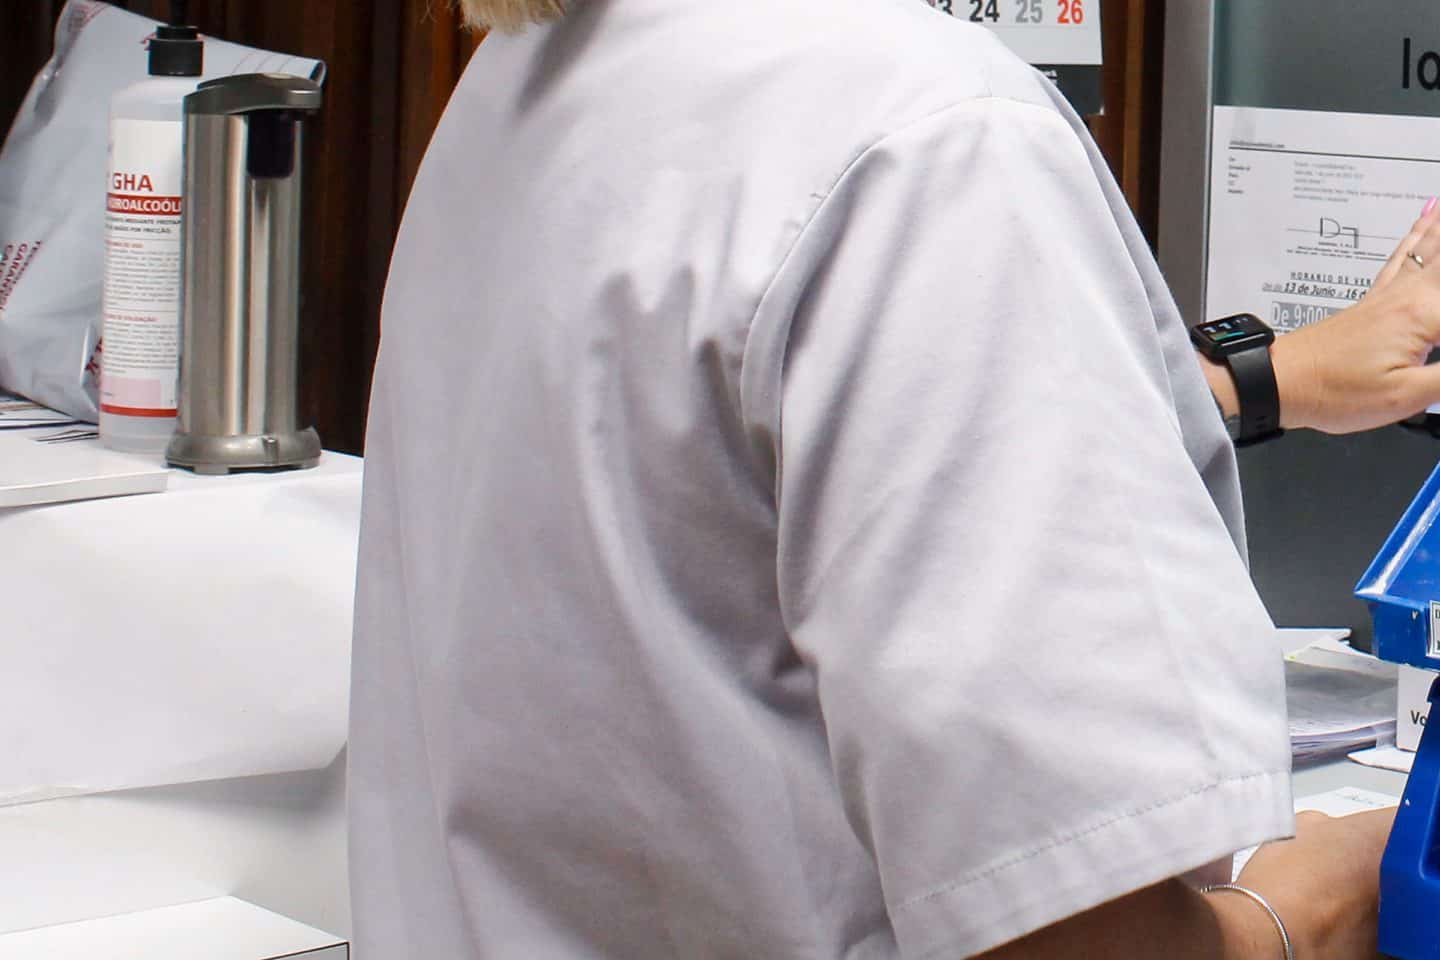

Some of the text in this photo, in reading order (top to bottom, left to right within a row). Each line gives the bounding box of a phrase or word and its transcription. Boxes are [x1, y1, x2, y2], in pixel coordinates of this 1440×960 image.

[112, 172, 153, 192] GHA
[1345, 289, 1358, 300] 16
[1271, 302, 1290, 327] De
